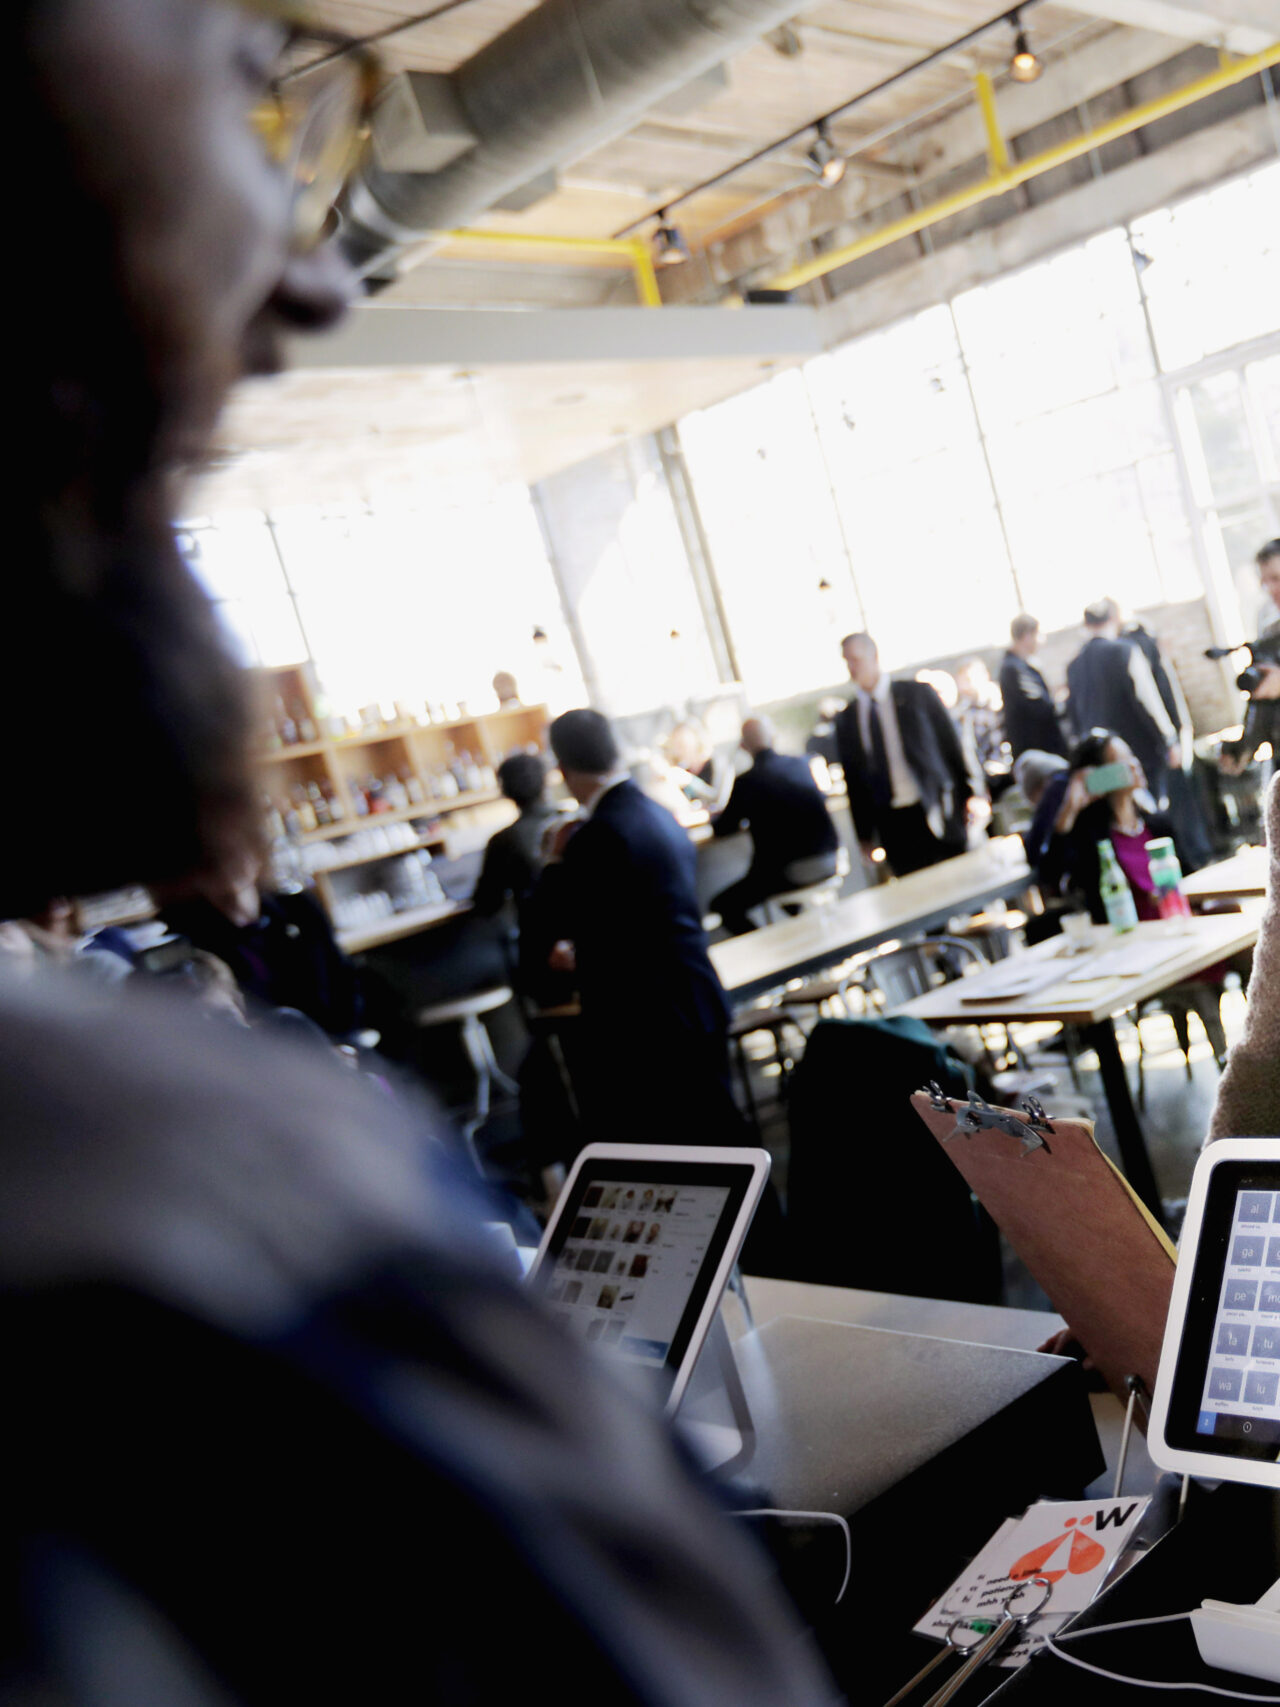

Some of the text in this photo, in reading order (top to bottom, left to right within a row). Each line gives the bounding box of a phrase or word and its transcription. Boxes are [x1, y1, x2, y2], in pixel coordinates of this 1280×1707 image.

[1241, 1247, 1254, 1259] ga
[1233, 1292, 1246, 1303] pe
[1263, 1337, 1273, 1349] tu
[1218, 1381, 1232, 1391] wa
[986, 1573, 1012, 1585] need
